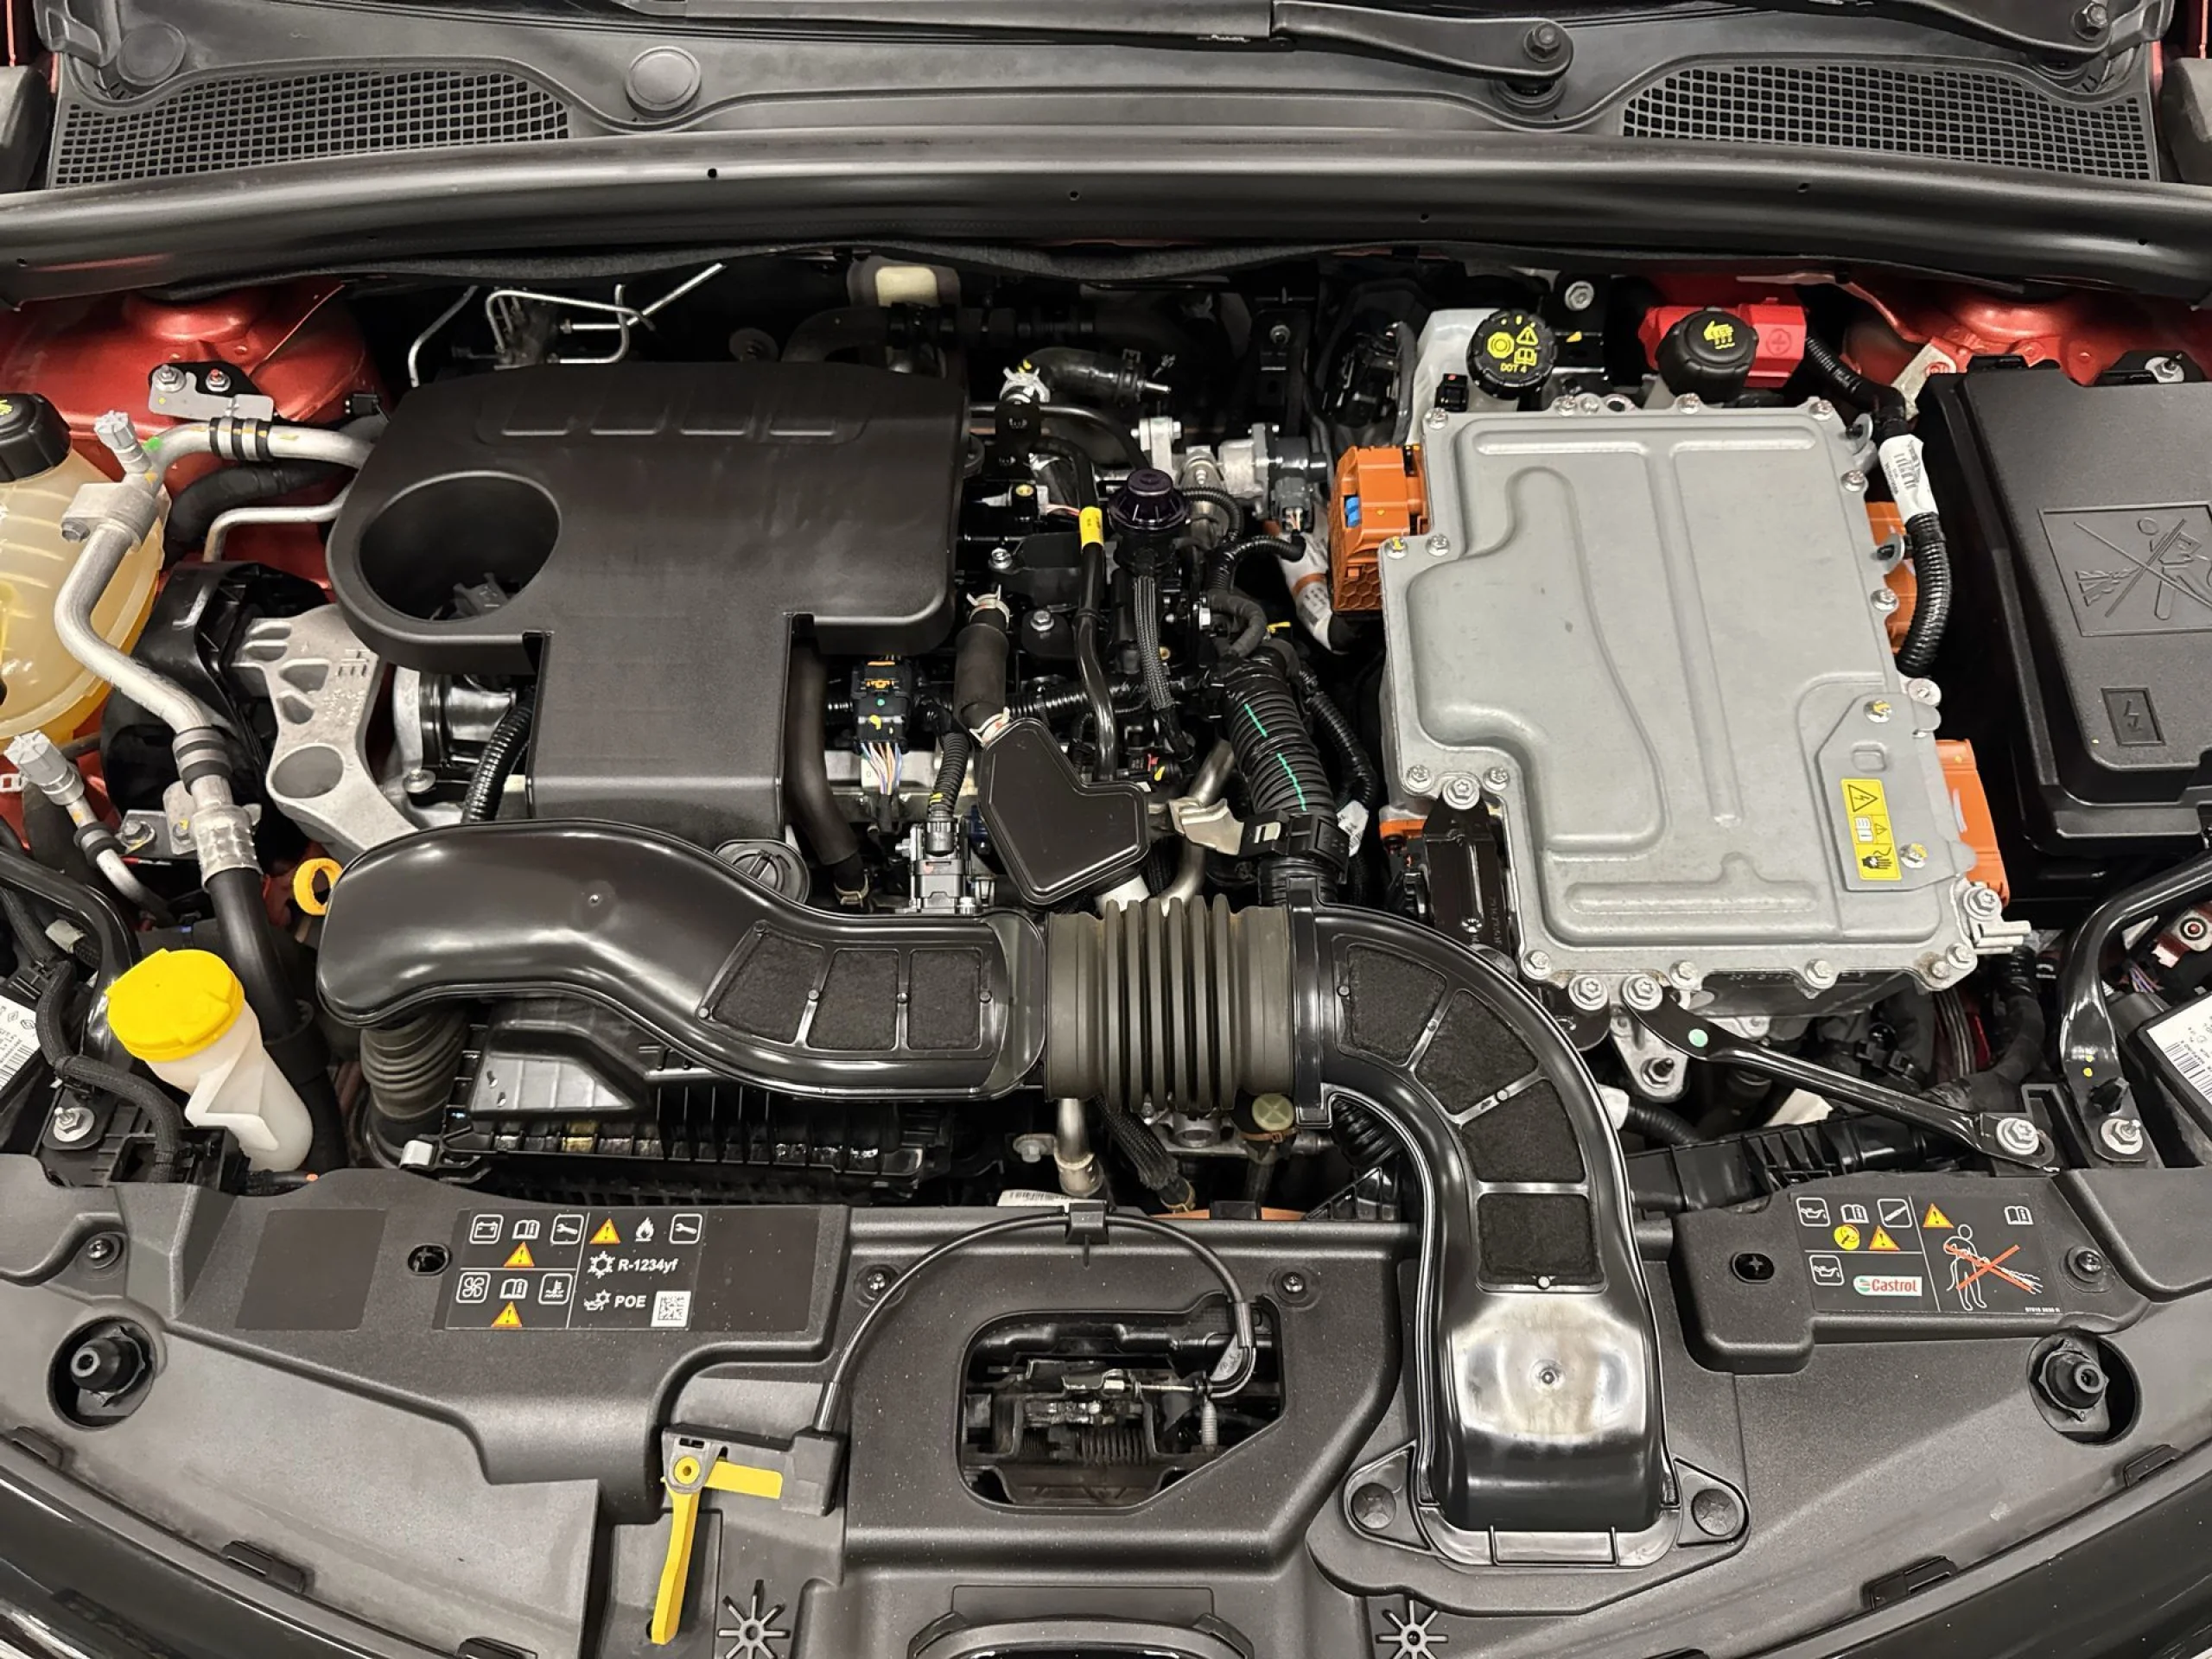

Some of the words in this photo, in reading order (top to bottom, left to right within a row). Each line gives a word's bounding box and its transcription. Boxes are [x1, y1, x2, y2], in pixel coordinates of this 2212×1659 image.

[1500, 363, 1518, 372] DOT
[618, 1258, 678, 1273] R-1234yf
[1872, 1279, 1917, 1294] Castrol
[614, 1295, 646, 1308] POE
